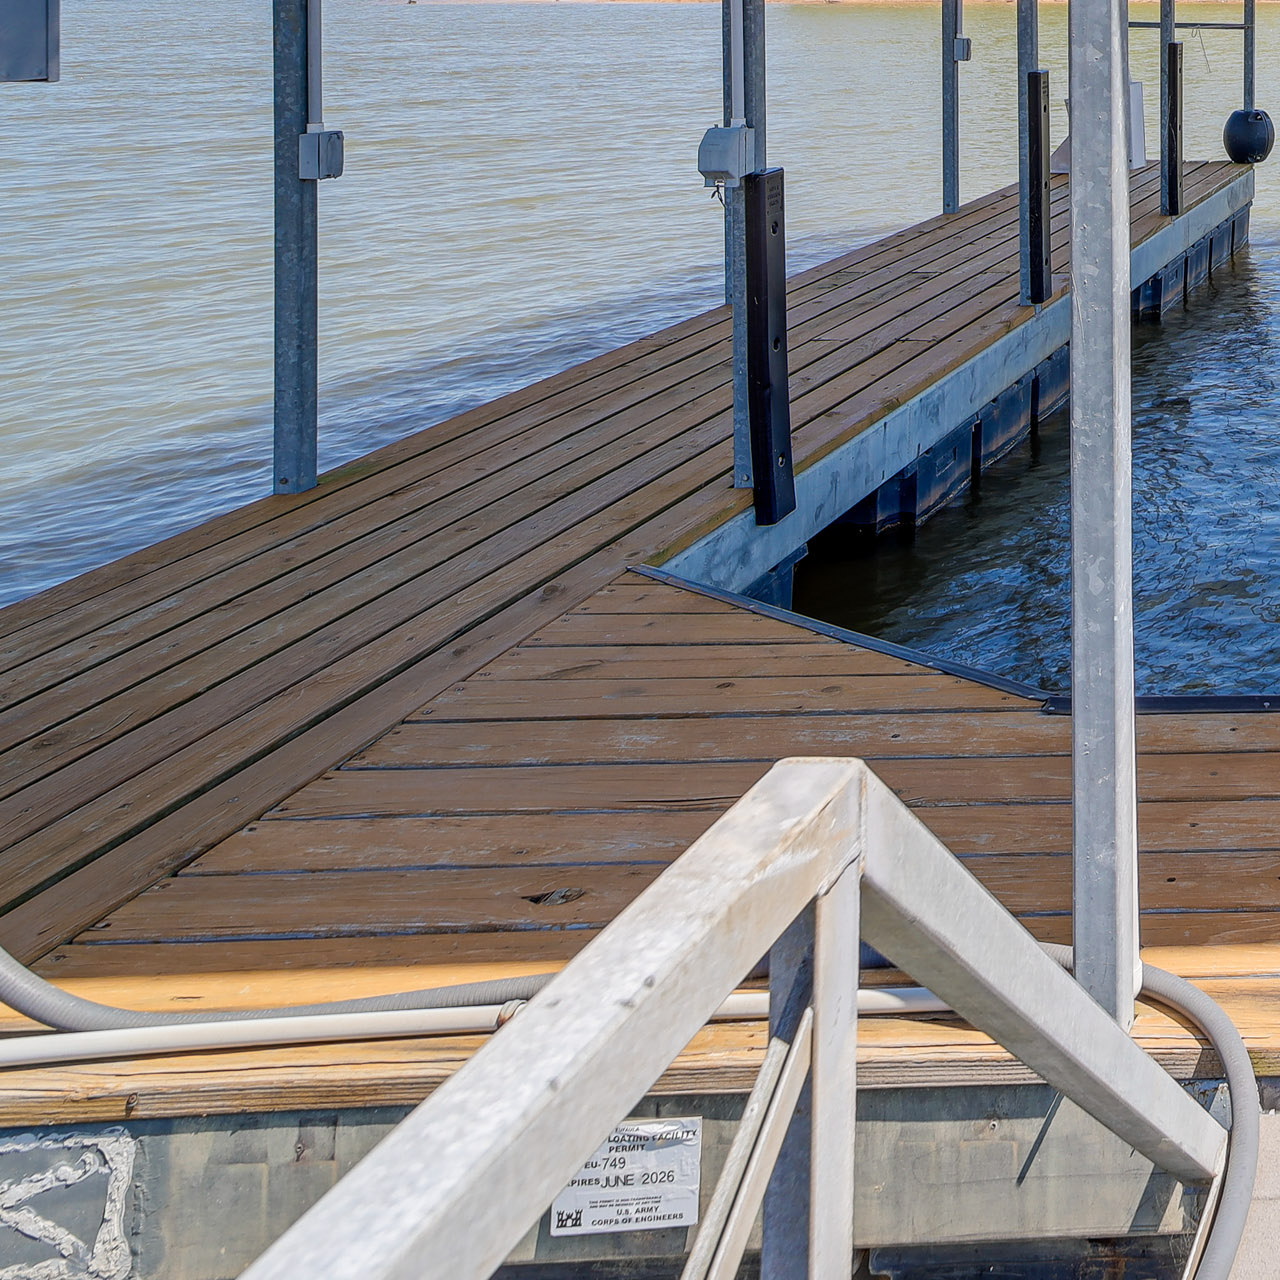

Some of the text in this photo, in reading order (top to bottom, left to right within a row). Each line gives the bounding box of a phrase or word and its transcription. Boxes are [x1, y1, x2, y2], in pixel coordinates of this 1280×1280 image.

[608, 1134, 650, 1144] LOATING
[608, 1144, 646, 1153] PERMIT
[584, 1157, 626, 1170] EU-749
[568, 1170, 675, 1189] PIRES JUNE 2026
[634, 1206, 660, 1215] ARMY
[591, 1213, 684, 1227] CORPS OF ENGINEERS
